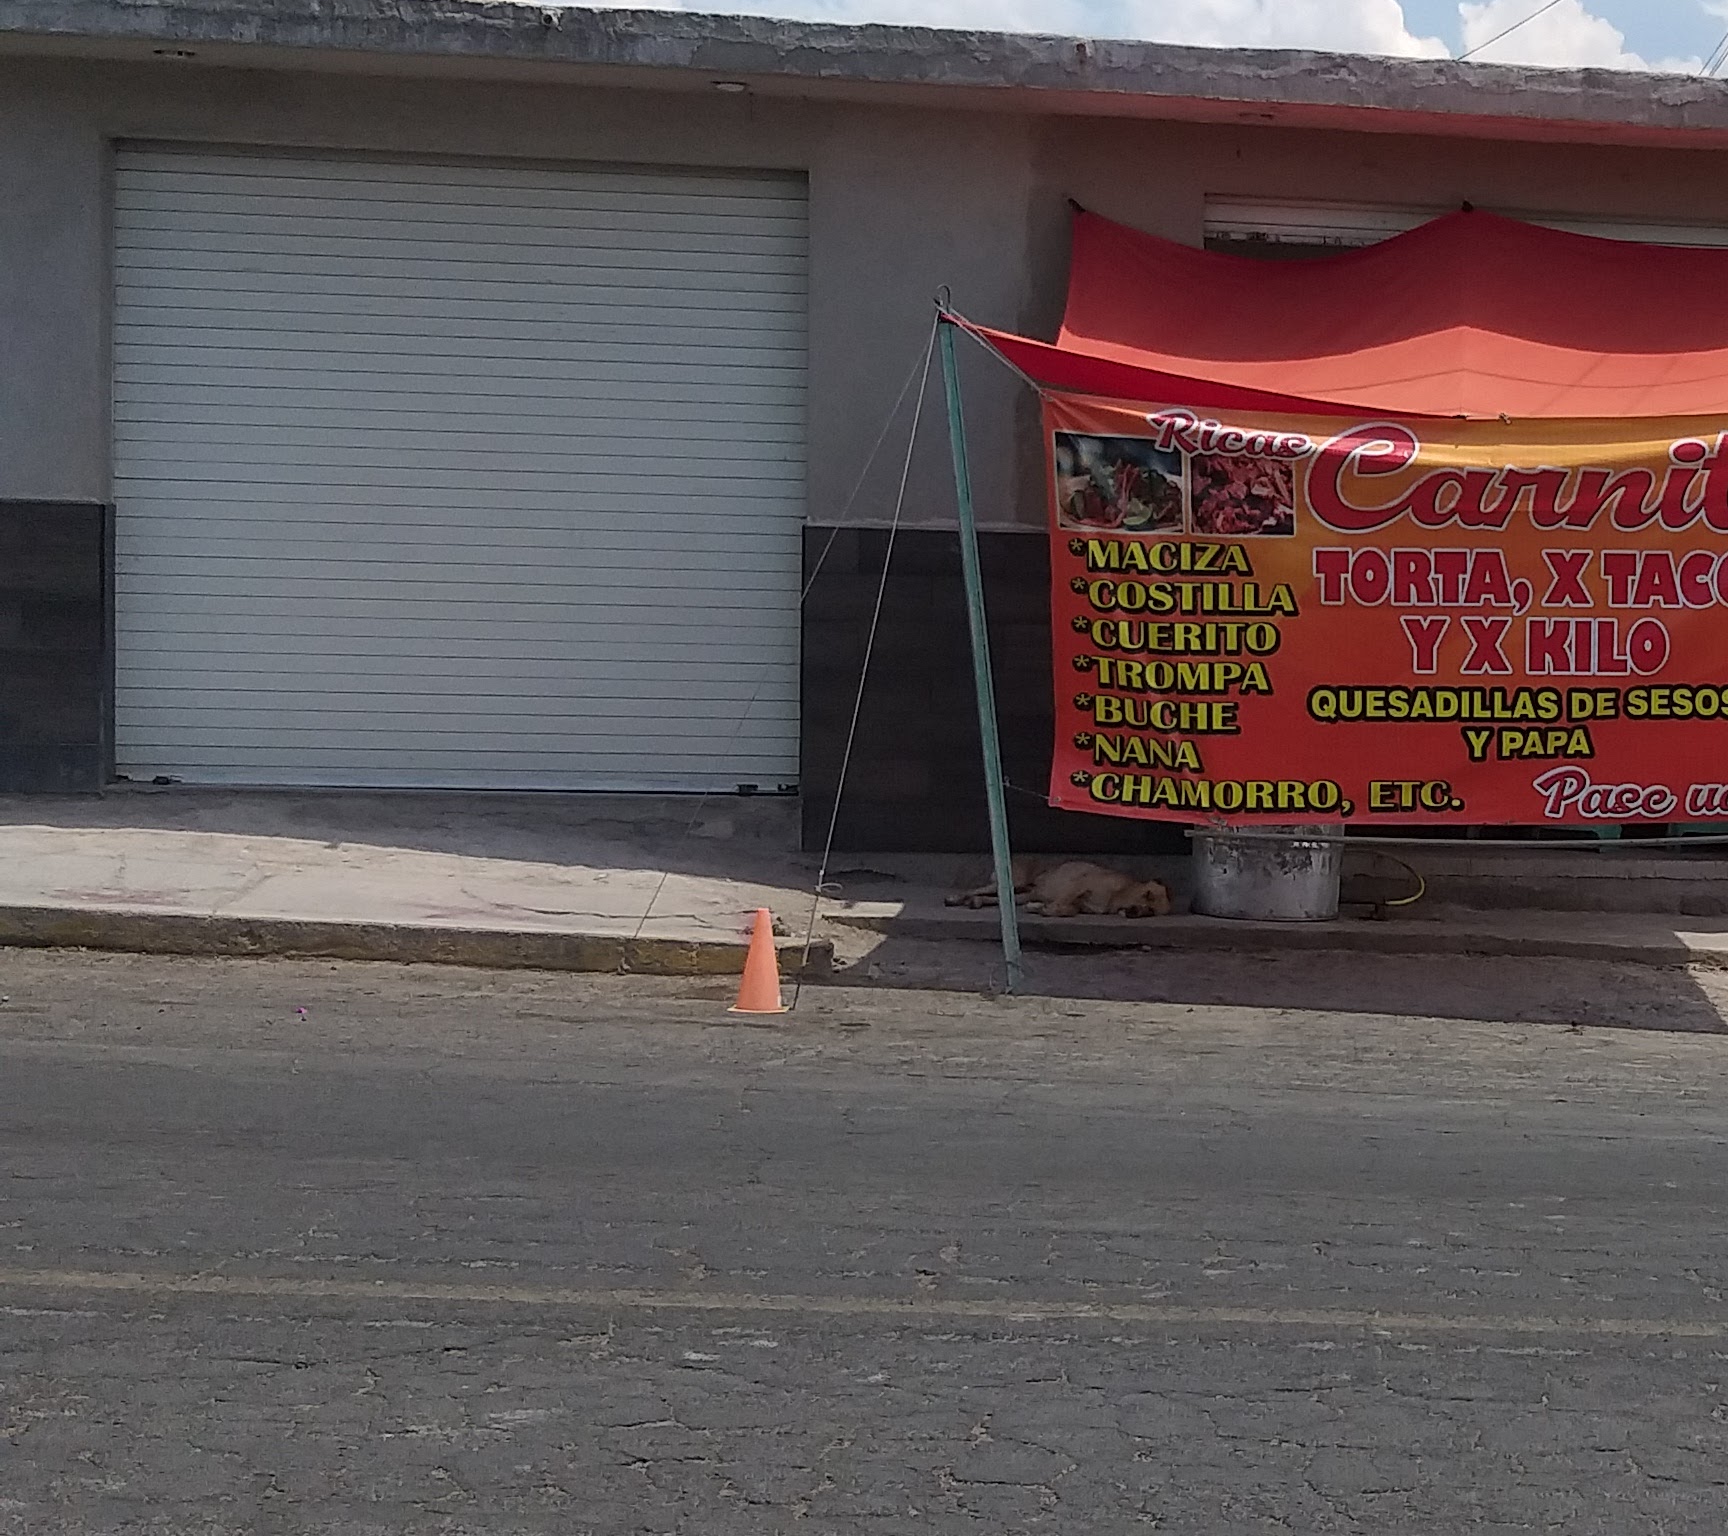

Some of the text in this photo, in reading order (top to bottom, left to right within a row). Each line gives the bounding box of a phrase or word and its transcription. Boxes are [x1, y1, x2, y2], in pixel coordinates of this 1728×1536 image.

[1147, 408, 1318, 461] Ricas
[1314, 548, 1532, 616] TORTA,
[1542, 550, 1593, 608] X
[1401, 616, 1671, 676] Y X KILO
[1310, 689, 1559, 719] QUESADILLAS
[1571, 691, 1617, 720] DE
[1465, 729, 1592, 758] Y PAPA
[1369, 781, 1464, 809] ETC.
